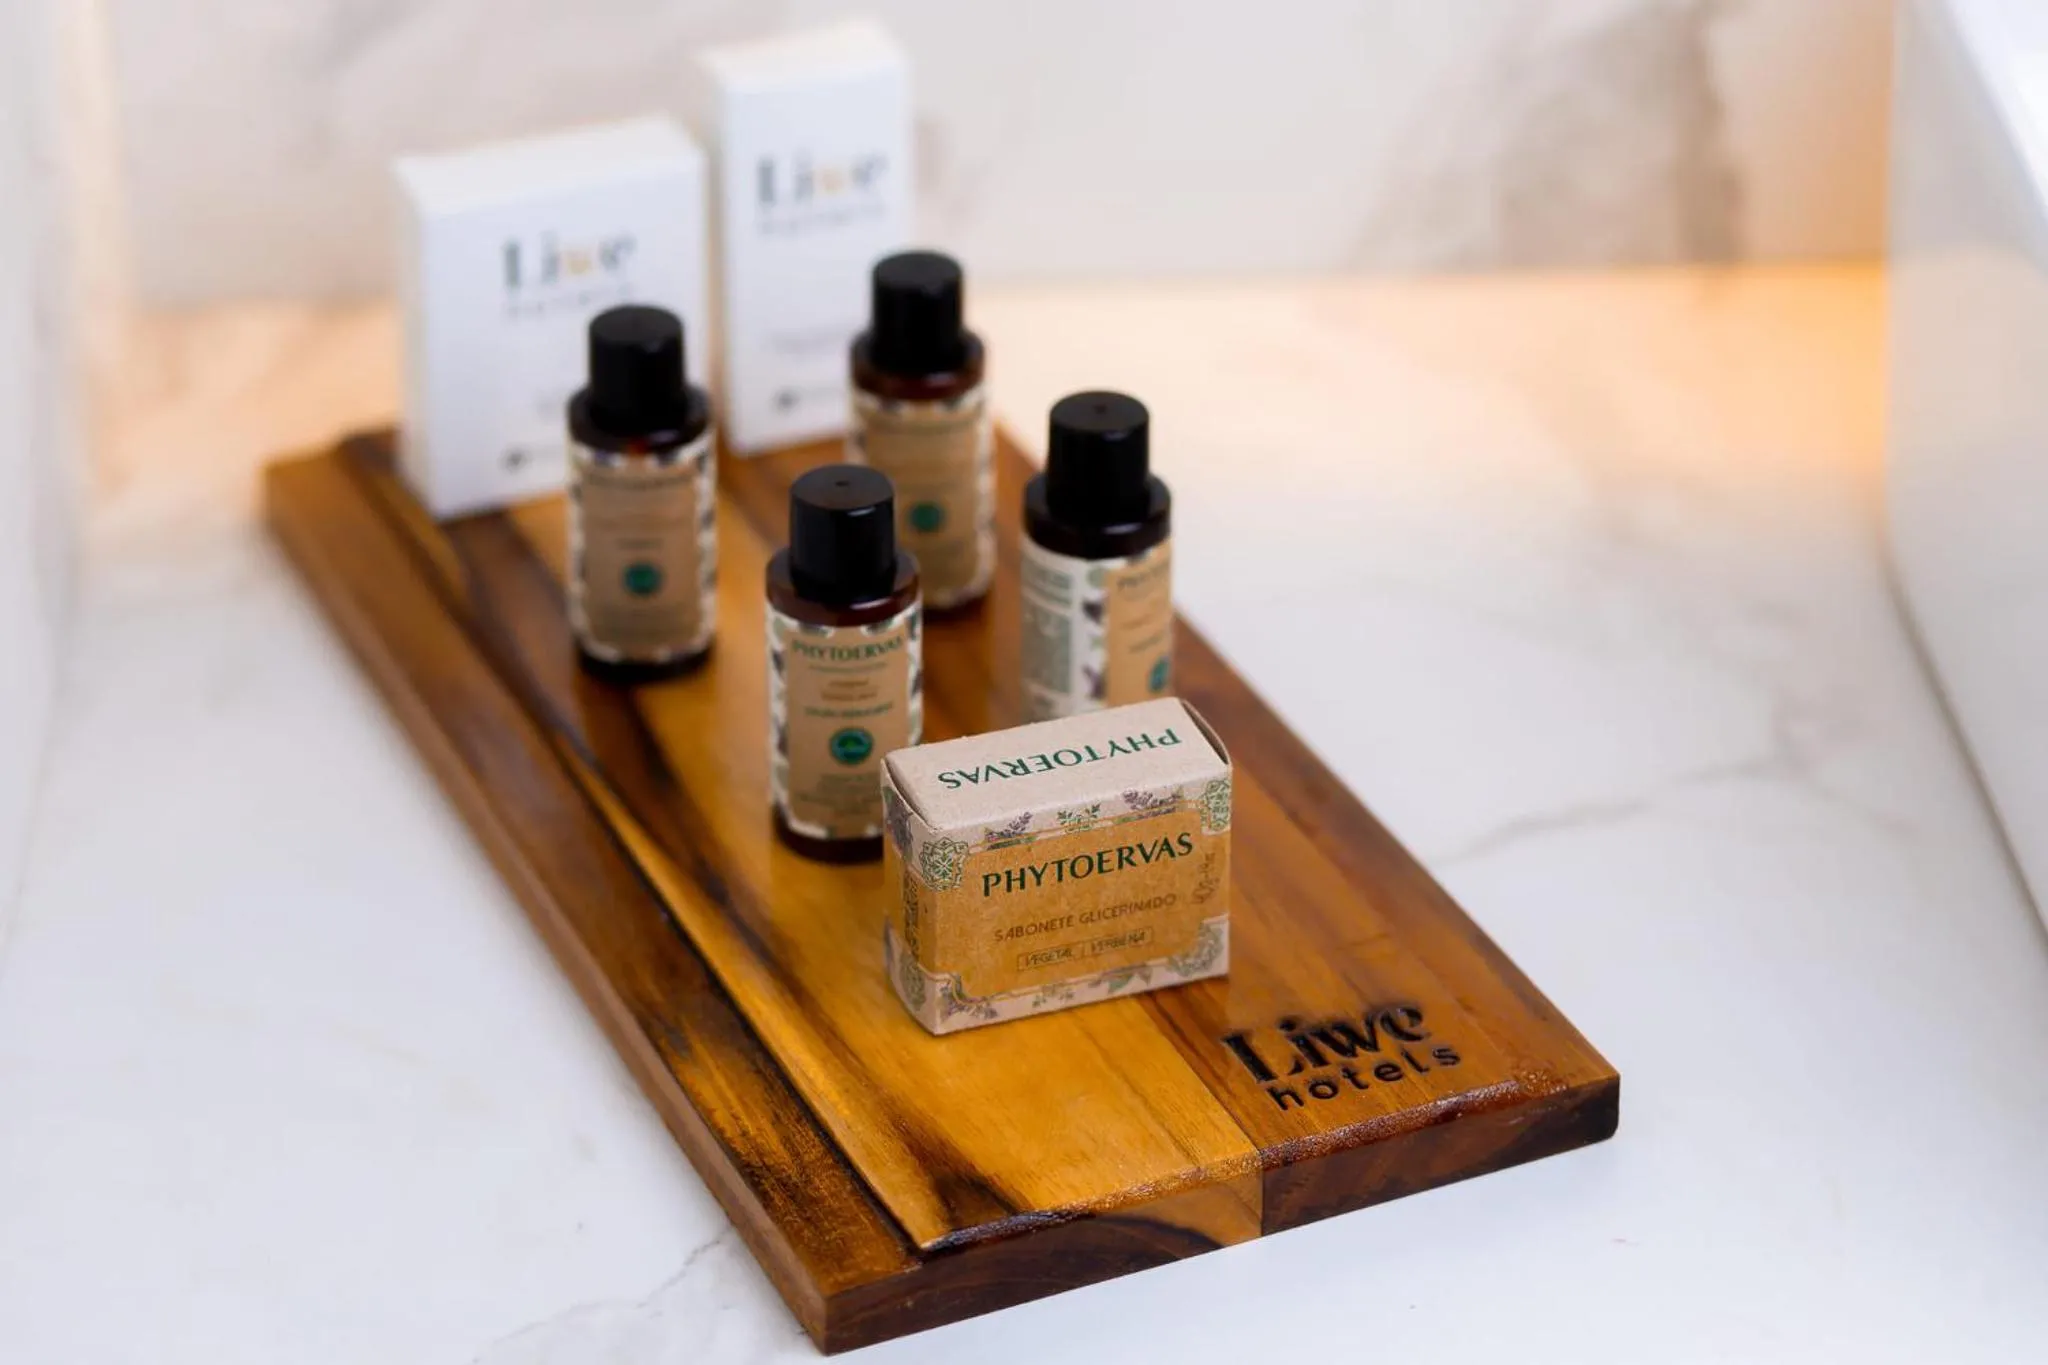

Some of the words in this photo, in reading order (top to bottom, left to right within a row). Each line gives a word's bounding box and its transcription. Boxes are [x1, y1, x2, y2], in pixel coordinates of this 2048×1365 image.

[937, 727, 1182, 790] PHYTOERVAS
[982, 831, 1194, 897] PHYTOERVAS
[994, 914, 1075, 942] SABONETE
[1079, 893, 1177, 925] GLICERINADO
[1222, 1004, 1431, 1083] Liwe
[1266, 1047, 1461, 1111] hotels
